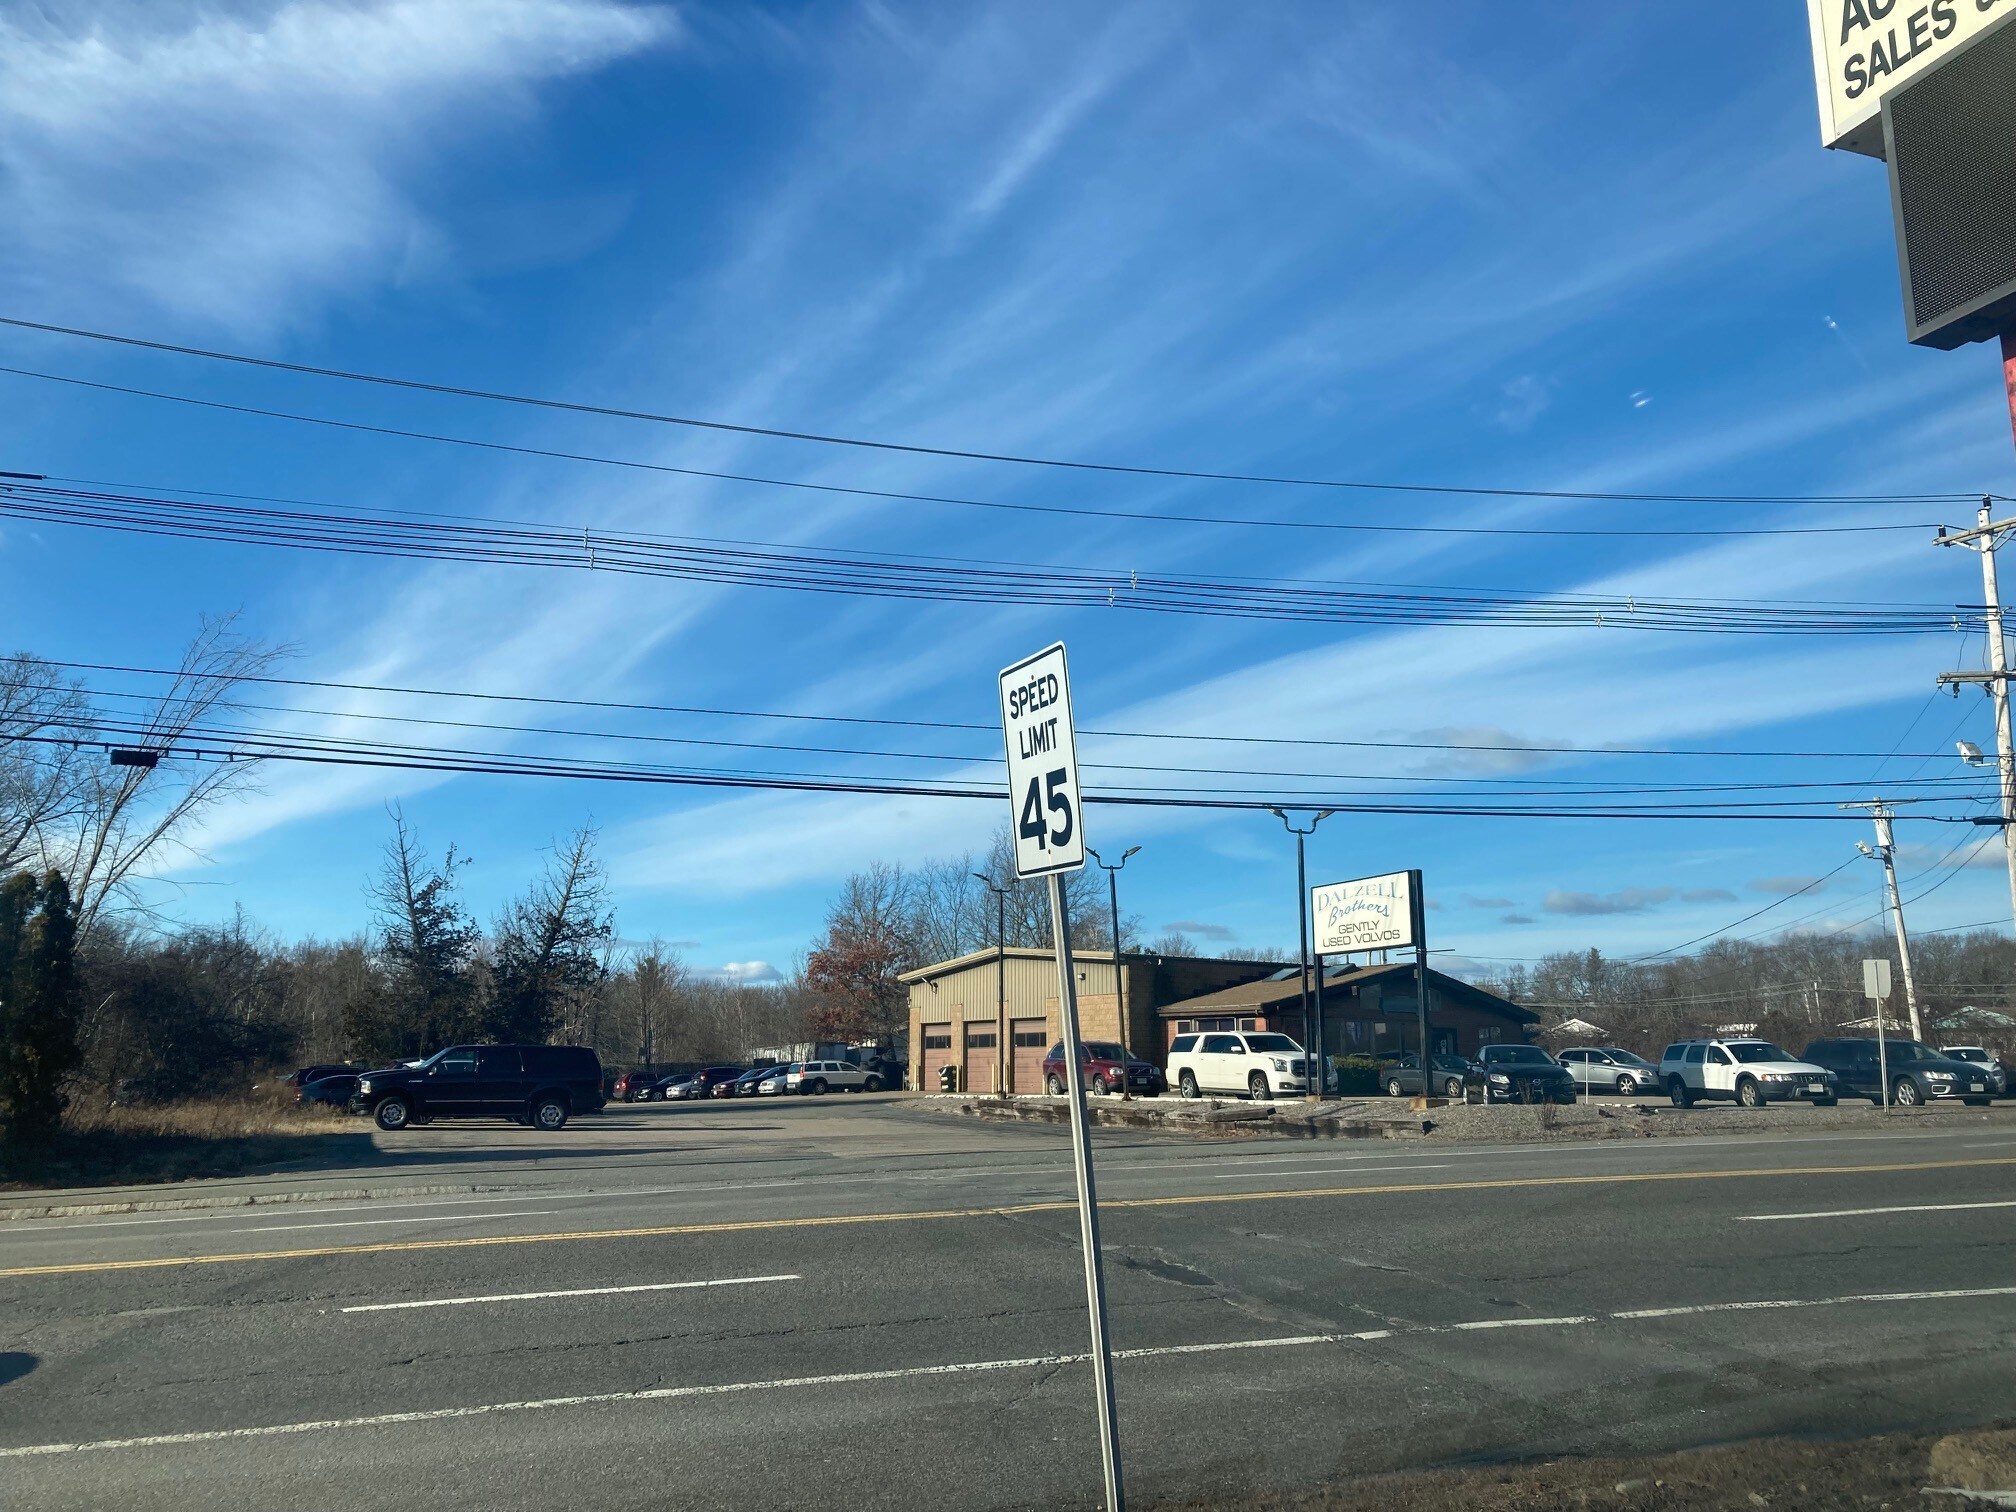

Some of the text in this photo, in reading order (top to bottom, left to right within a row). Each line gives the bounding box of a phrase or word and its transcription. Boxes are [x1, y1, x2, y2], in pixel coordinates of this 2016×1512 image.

[1844, 0, 1957, 99] SALES
[1009, 673, 1059, 720] SPEED
[1019, 717, 1058, 760] LIMIT
[1019, 767, 1073, 851] 45
[1317, 881, 1404, 912] DALZELL
[1327, 899, 1390, 928] Brothers
[1322, 929, 1400, 948] USED VOLVOS
[1338, 920, 1380, 934] GENTLY
